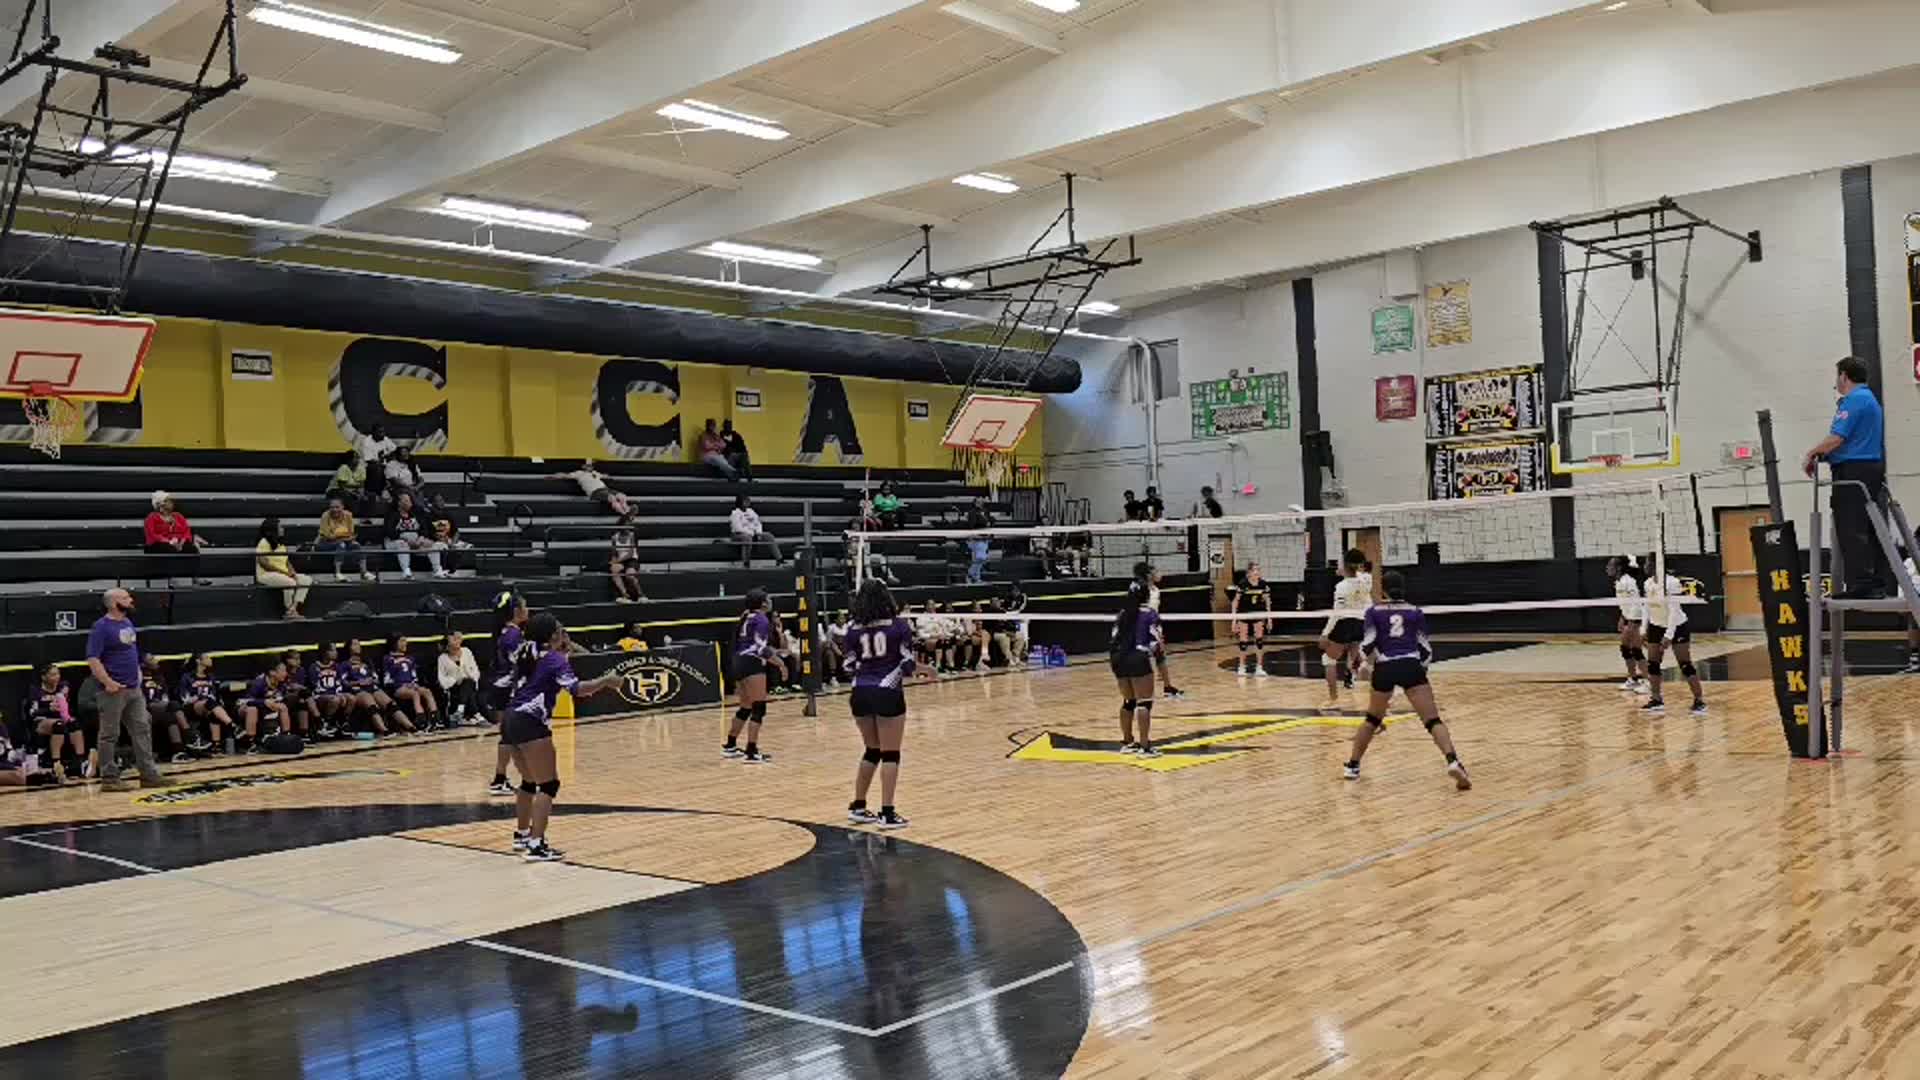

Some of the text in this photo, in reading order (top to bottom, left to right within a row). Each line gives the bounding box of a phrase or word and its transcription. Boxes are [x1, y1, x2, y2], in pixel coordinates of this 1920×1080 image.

[328, 338, 863, 463] C C A
[859, 631, 888, 659] 10
[1389, 614, 1405, 638] 2
[1769, 568, 1809, 726] HAWKS
